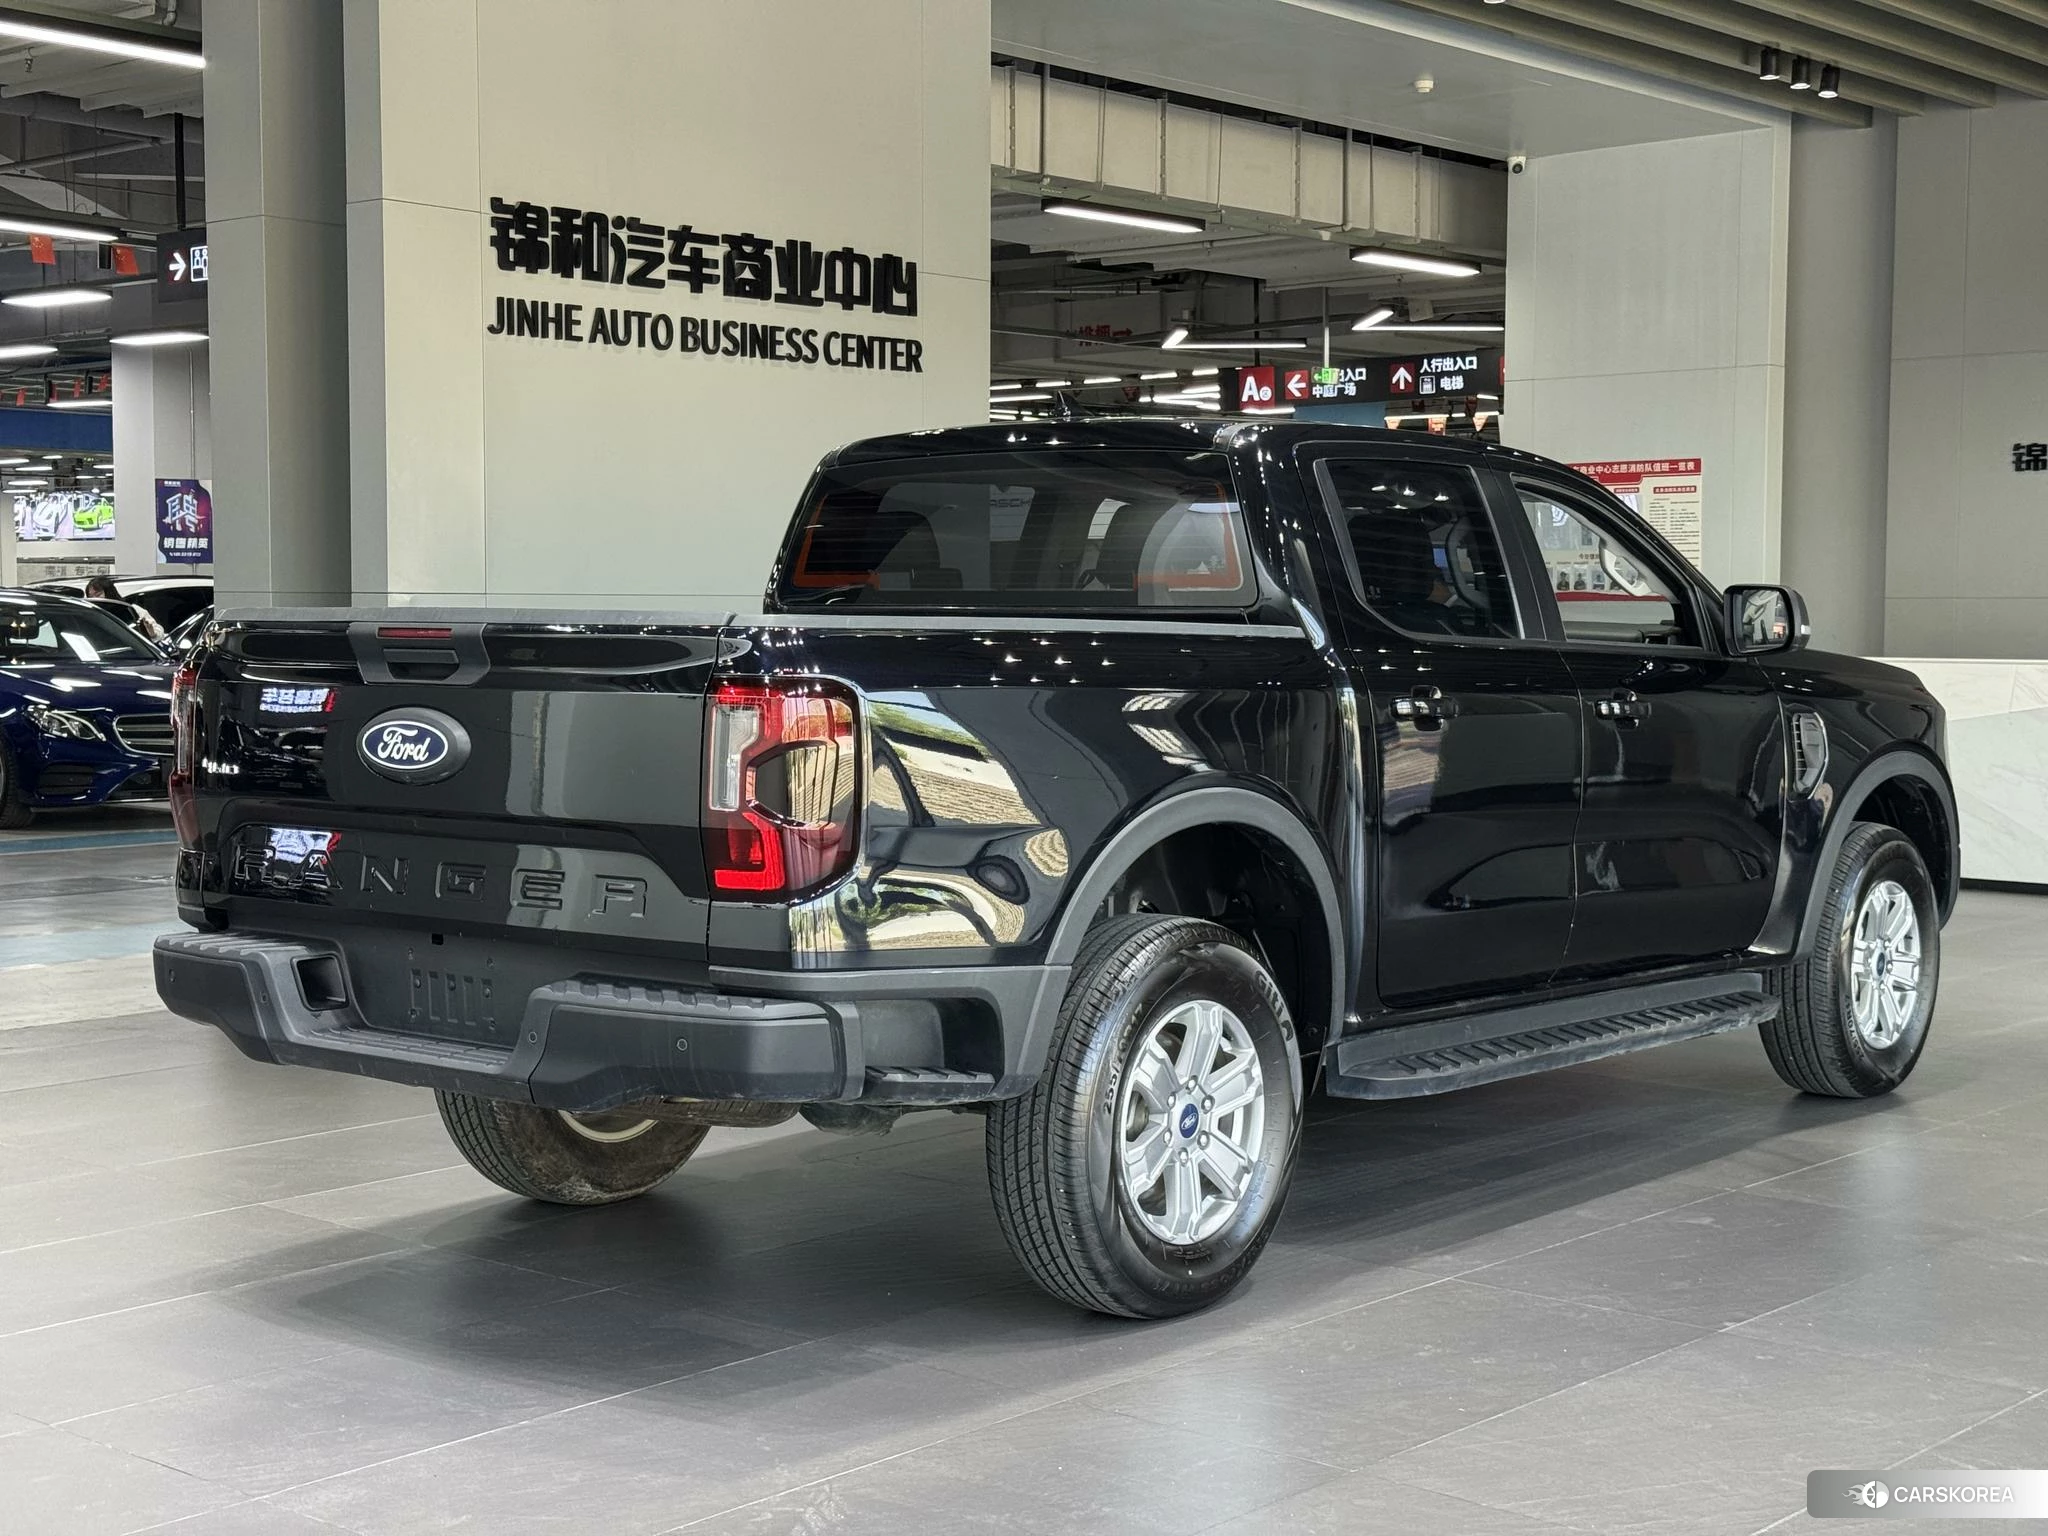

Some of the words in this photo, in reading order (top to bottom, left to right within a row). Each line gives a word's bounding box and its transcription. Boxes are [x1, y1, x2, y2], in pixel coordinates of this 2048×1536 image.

[490, 197, 917, 317] 锦和汽车商业中心
[487, 297, 583, 341] JINHE
[588, 307, 673, 351] AUTO
[680, 317, 819, 364] BUSINESS
[823, 331, 923, 373] CENTER
[1420, 356, 1477, 373] 人行出入口
[1312, 382, 1356, 398] 中庭广场
[1440, 375, 1464, 390] 电梯
[378, 727, 431, 761] Ford
[234, 846, 648, 919] RANGER
